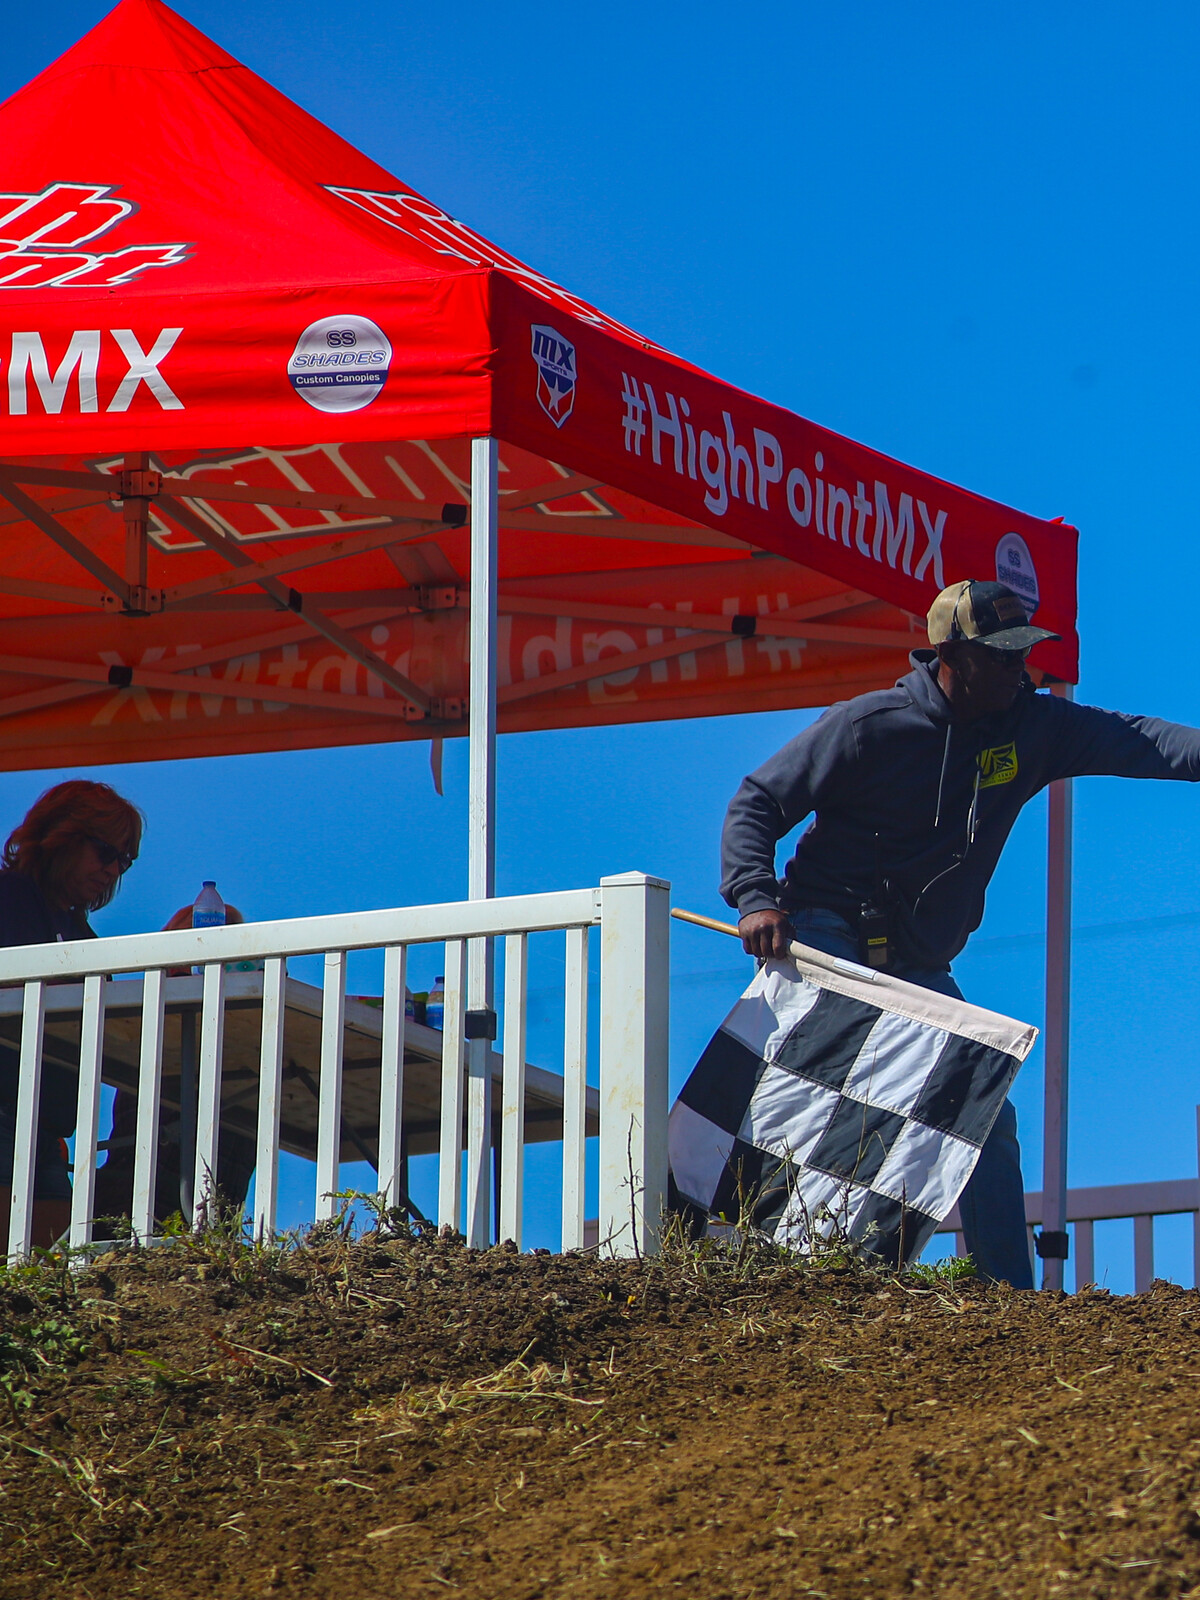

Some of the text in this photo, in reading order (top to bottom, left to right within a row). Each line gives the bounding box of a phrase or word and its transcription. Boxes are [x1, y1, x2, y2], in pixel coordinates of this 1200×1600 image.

[326, 329, 357, 348] SS
[293, 350, 387, 368] SHADES
[0, 327, 186, 416] MX
[296, 373, 380, 385] Custom Canopies
[621, 371, 949, 590] #HighPointMX
